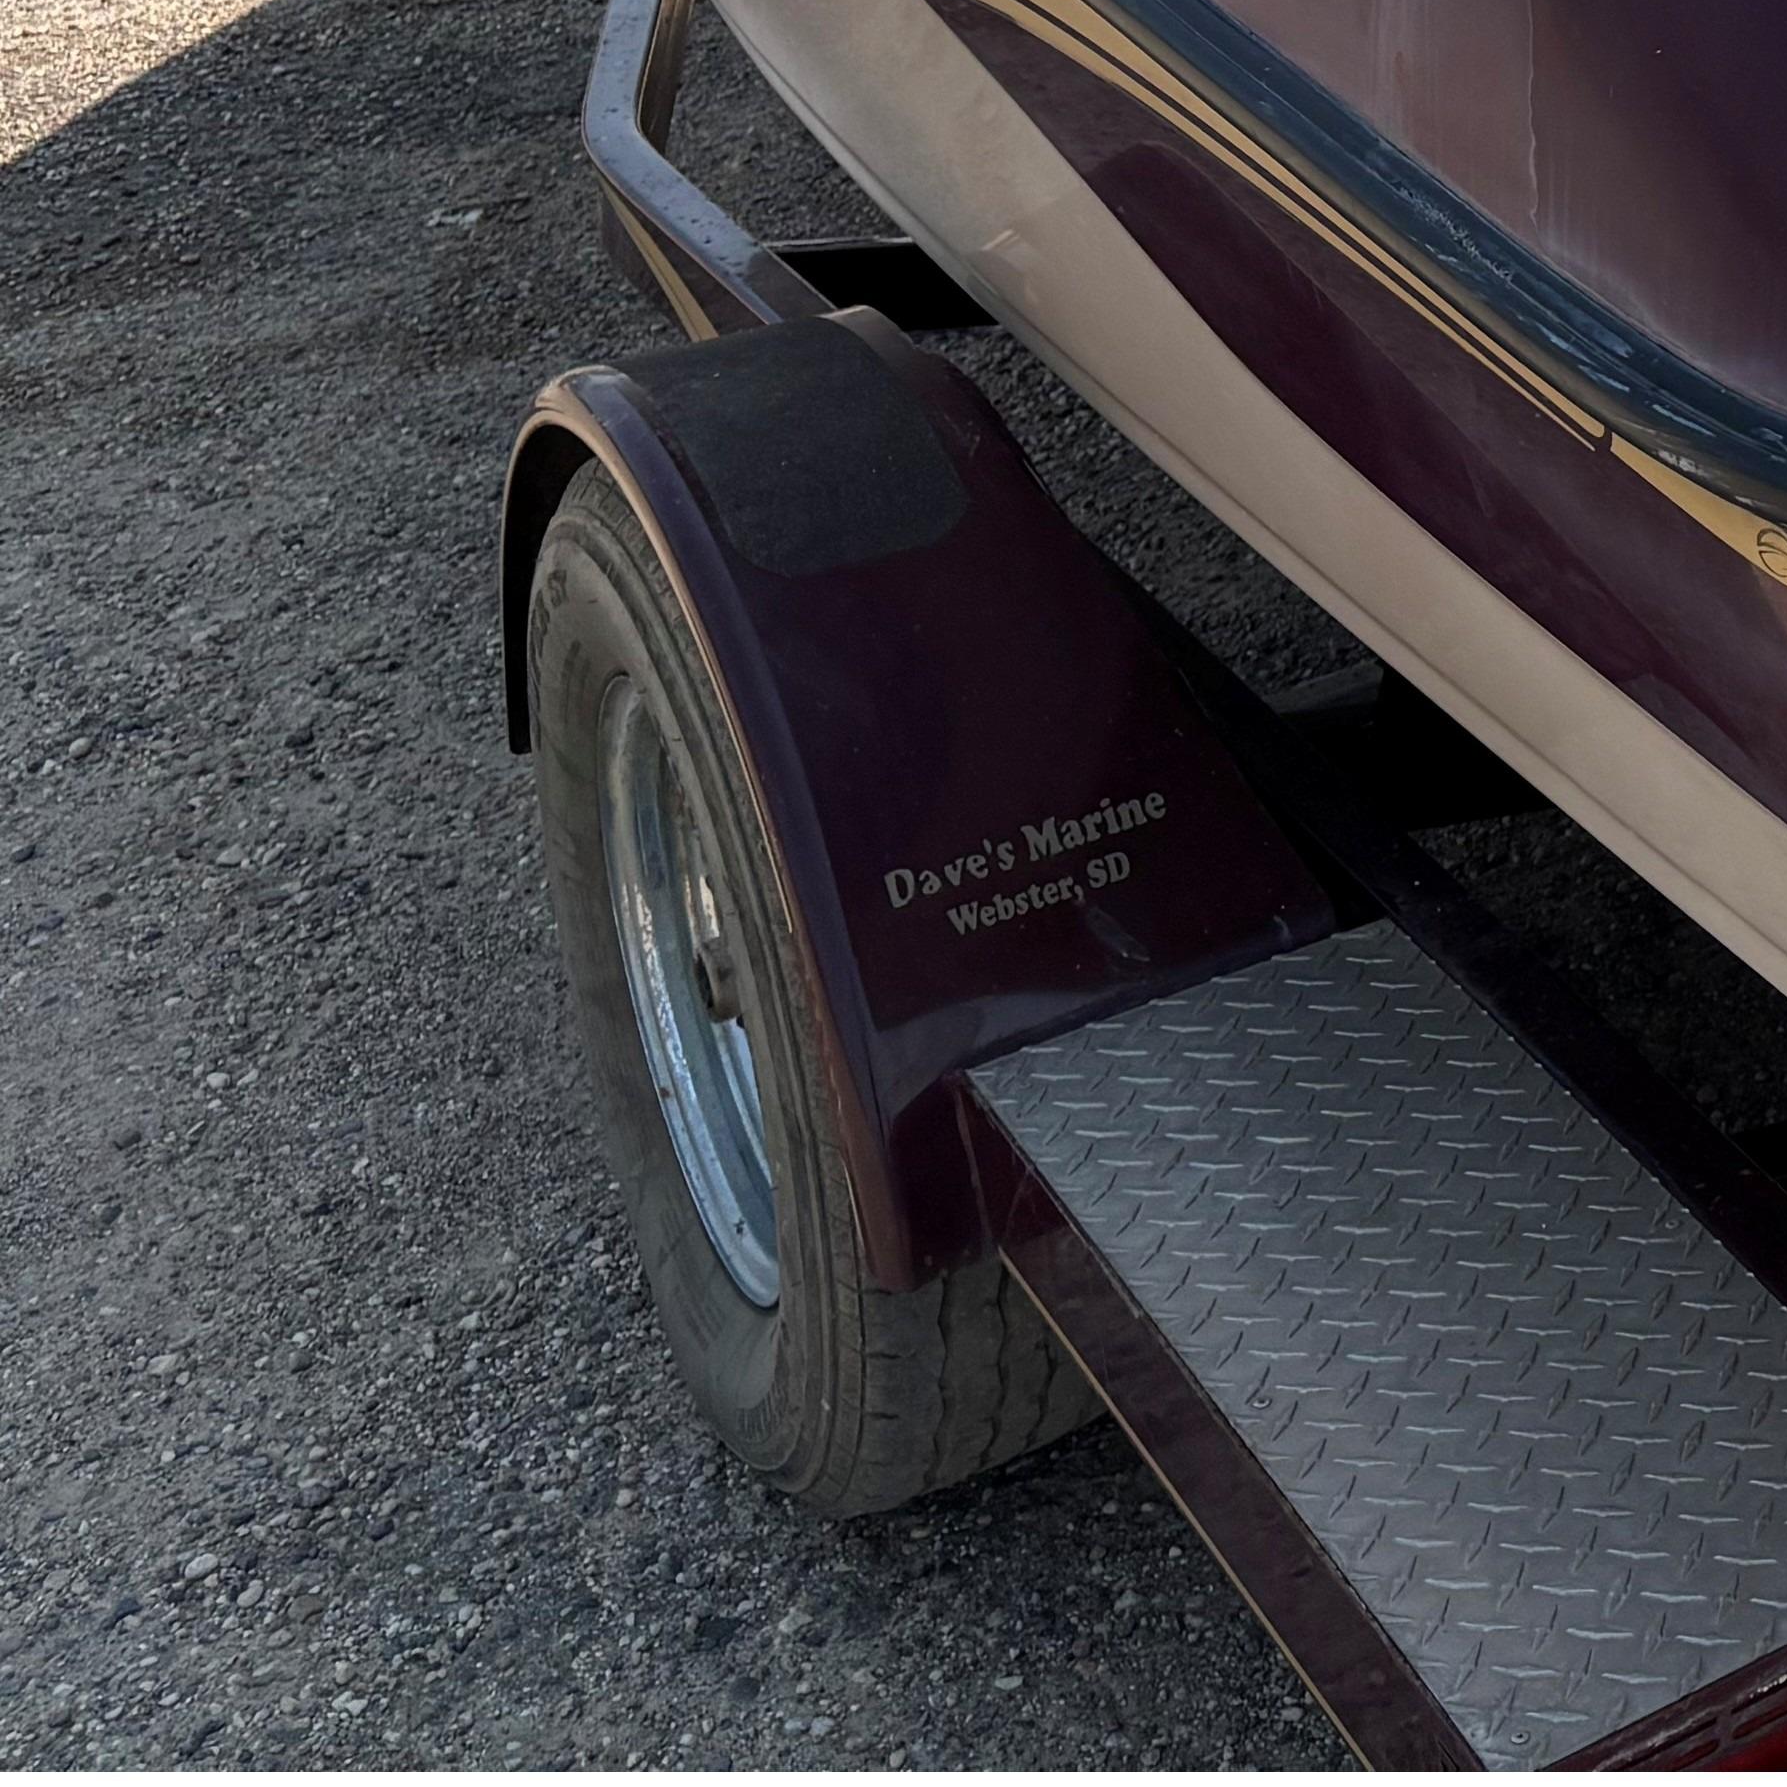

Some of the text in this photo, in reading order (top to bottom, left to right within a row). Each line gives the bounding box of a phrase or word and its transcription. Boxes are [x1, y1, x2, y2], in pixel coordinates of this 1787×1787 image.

[883, 791, 1167, 909] Dave's Marine
[945, 850, 1131, 936] Webster, SD
